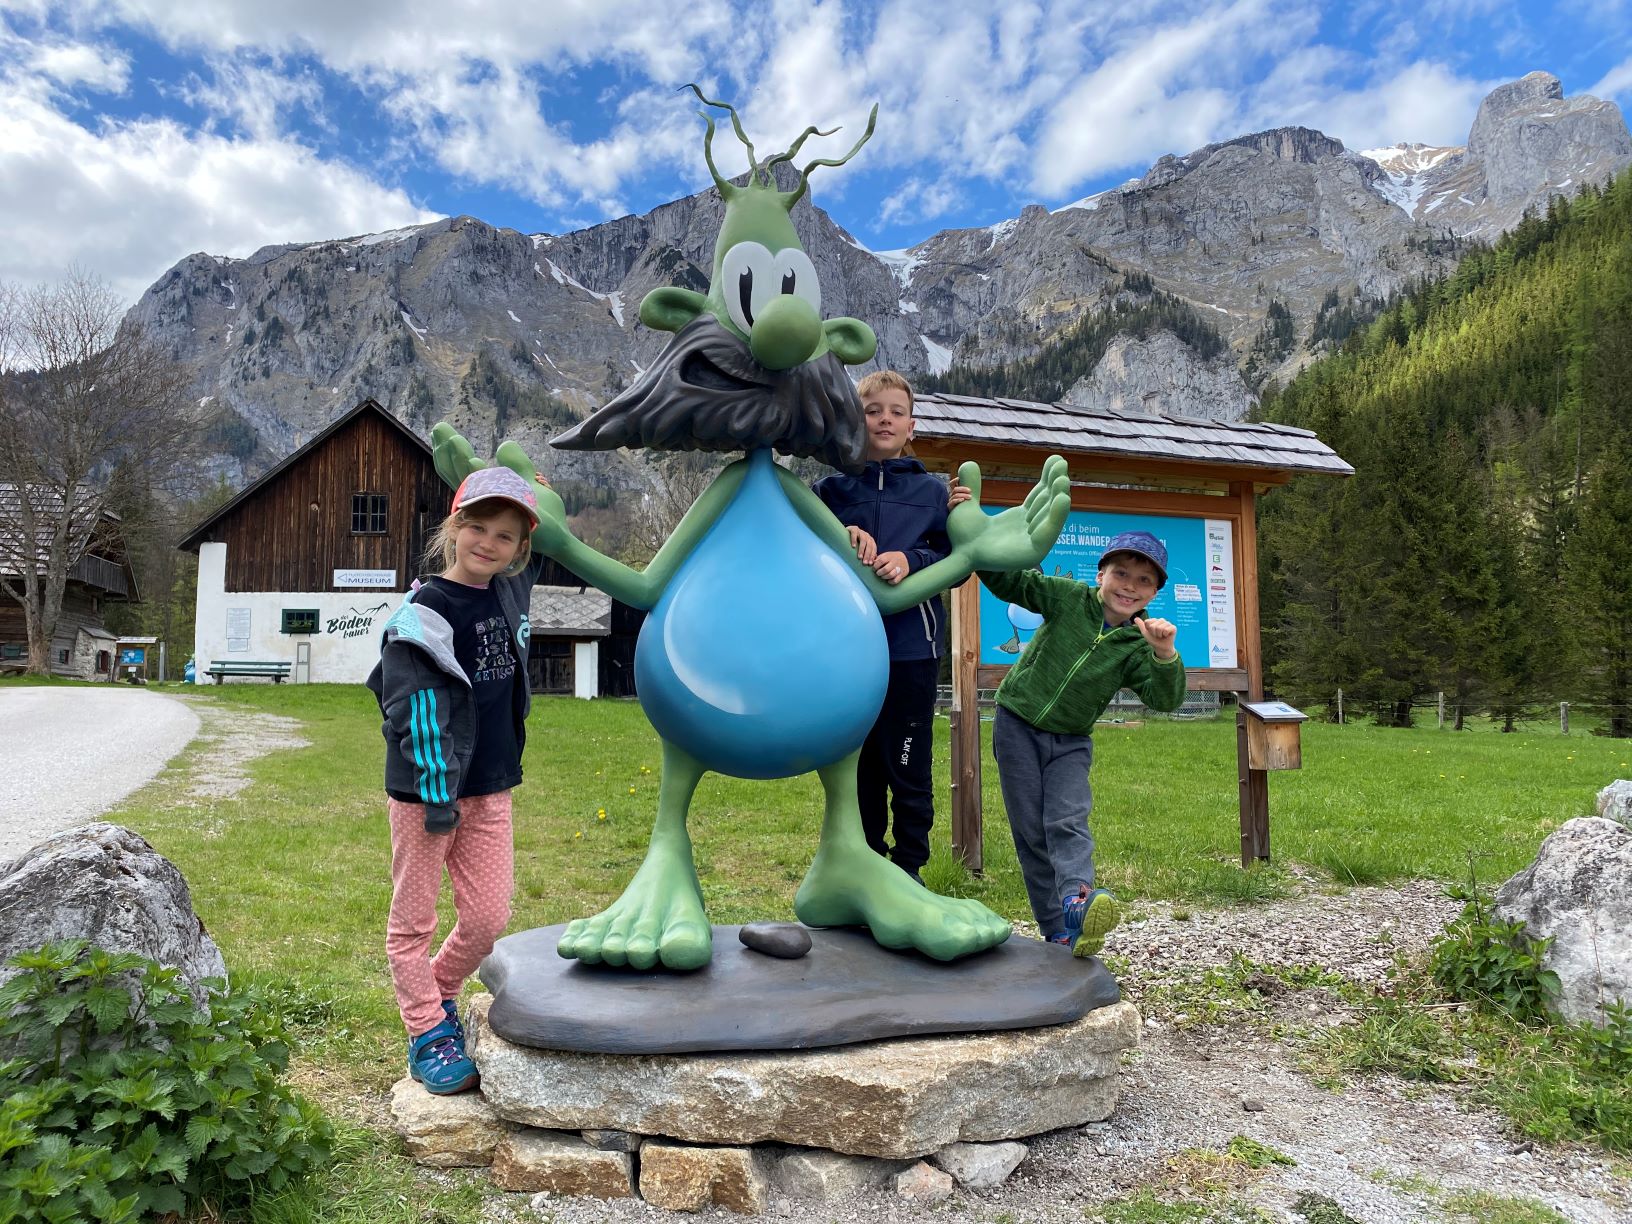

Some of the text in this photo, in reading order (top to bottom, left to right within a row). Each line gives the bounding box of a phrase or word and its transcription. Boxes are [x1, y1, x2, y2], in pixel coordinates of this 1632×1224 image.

[1068, 523, 1077, 533] di
[1079, 524, 1100, 534] beim
[1055, 534, 1111, 547] SSER.WANDER
[343, 627, 369, 639] bauer
[900, 737, 913, 766] PLAY-OFF
